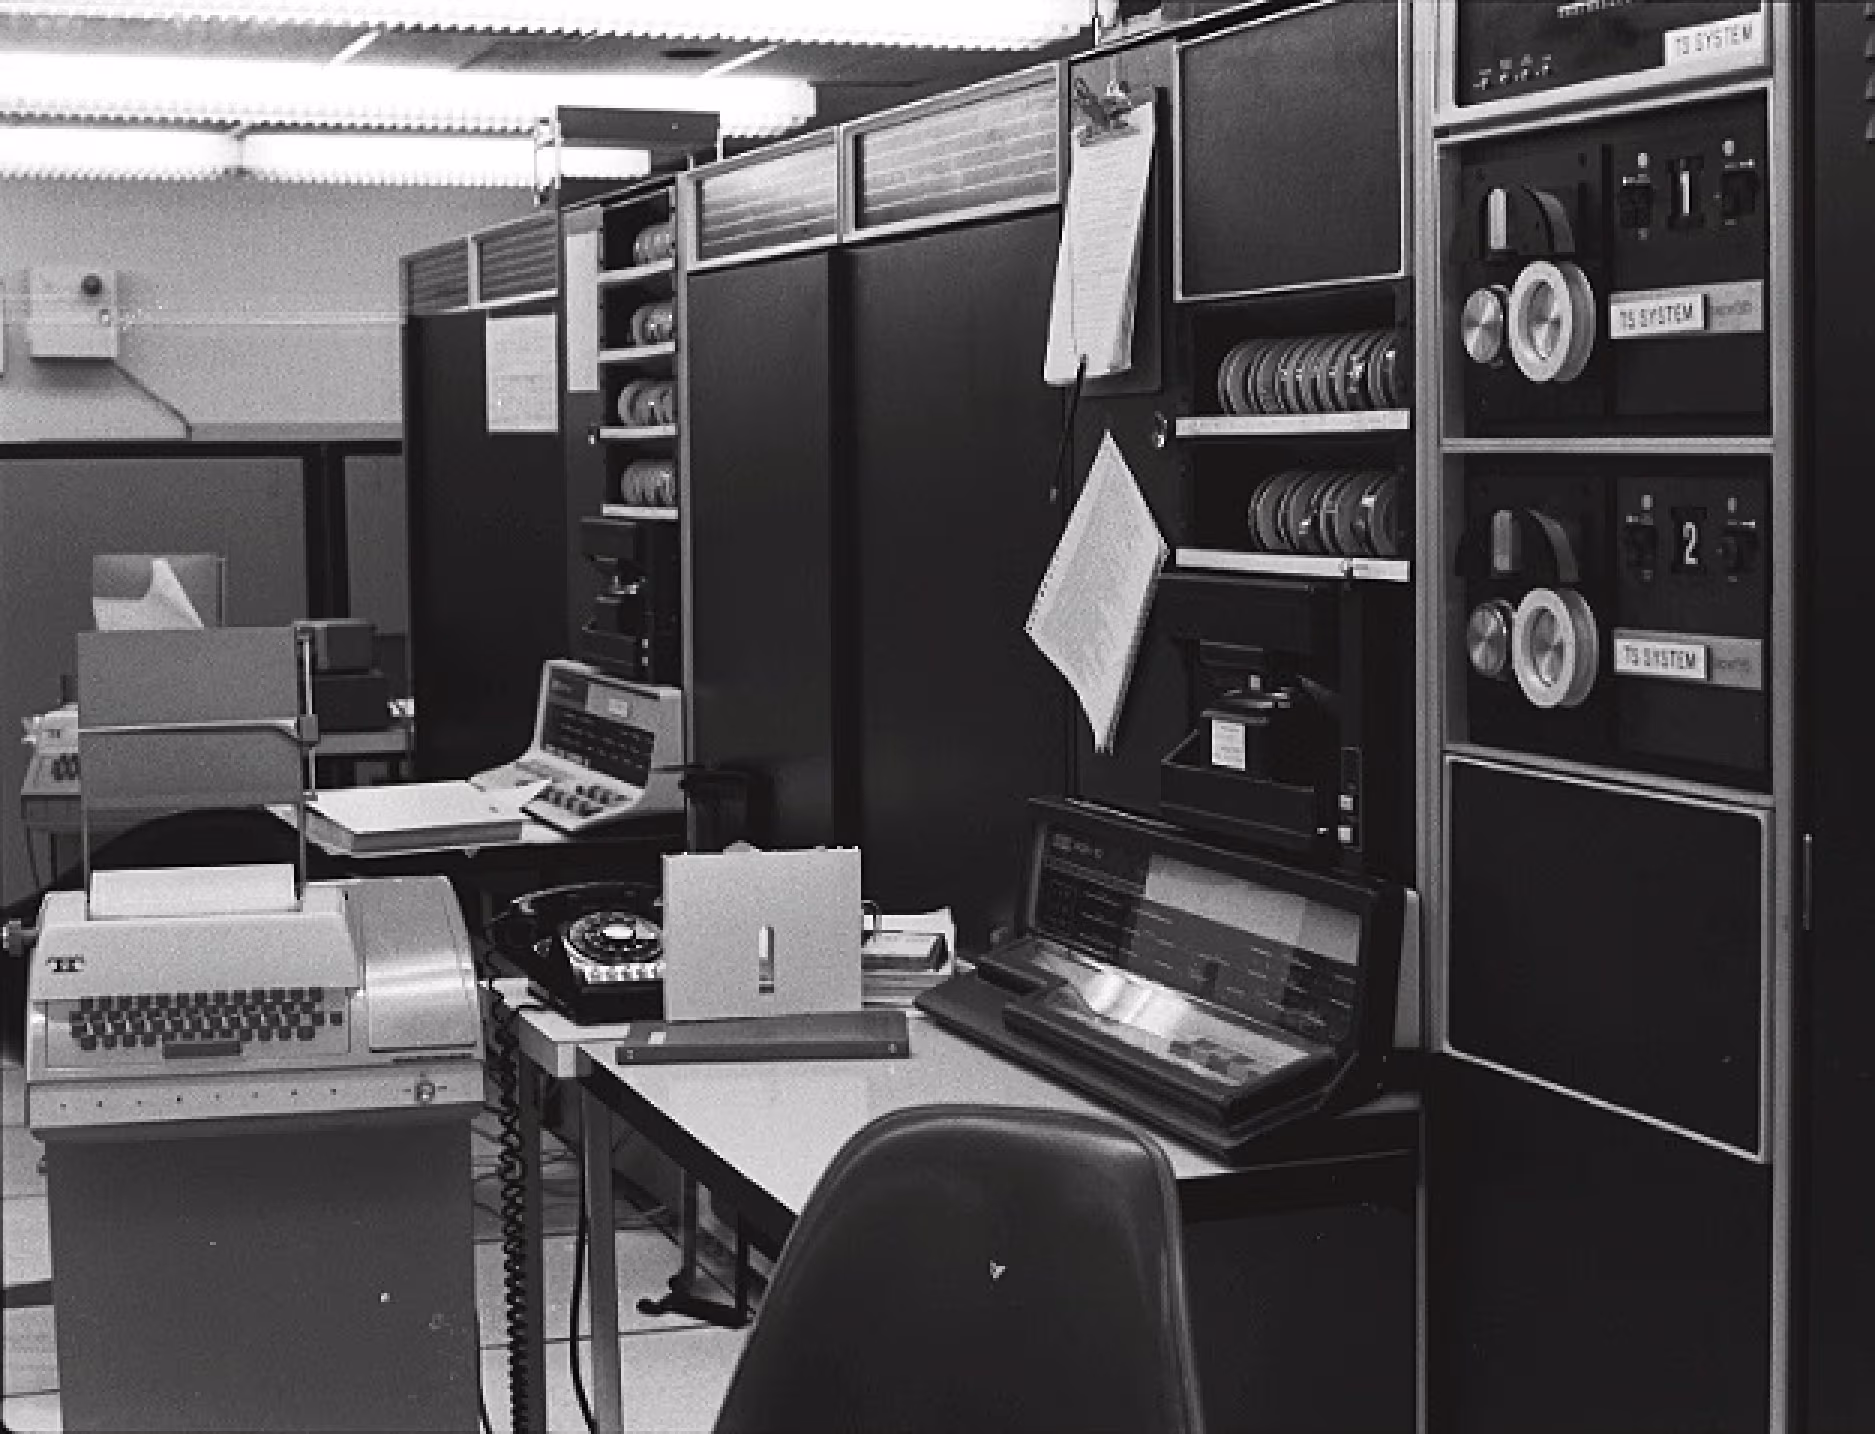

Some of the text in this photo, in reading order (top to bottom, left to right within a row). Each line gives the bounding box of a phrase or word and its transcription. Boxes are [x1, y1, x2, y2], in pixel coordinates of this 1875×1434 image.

[1694, 22, 1753, 52] SYSTEM
[1619, 309, 1636, 331] TS
[1640, 302, 1693, 328] SYSTEM
[1682, 520, 1699, 565] 2
[1622, 645, 1639, 667] TS
[1643, 648, 1696, 670] SYSTEM
